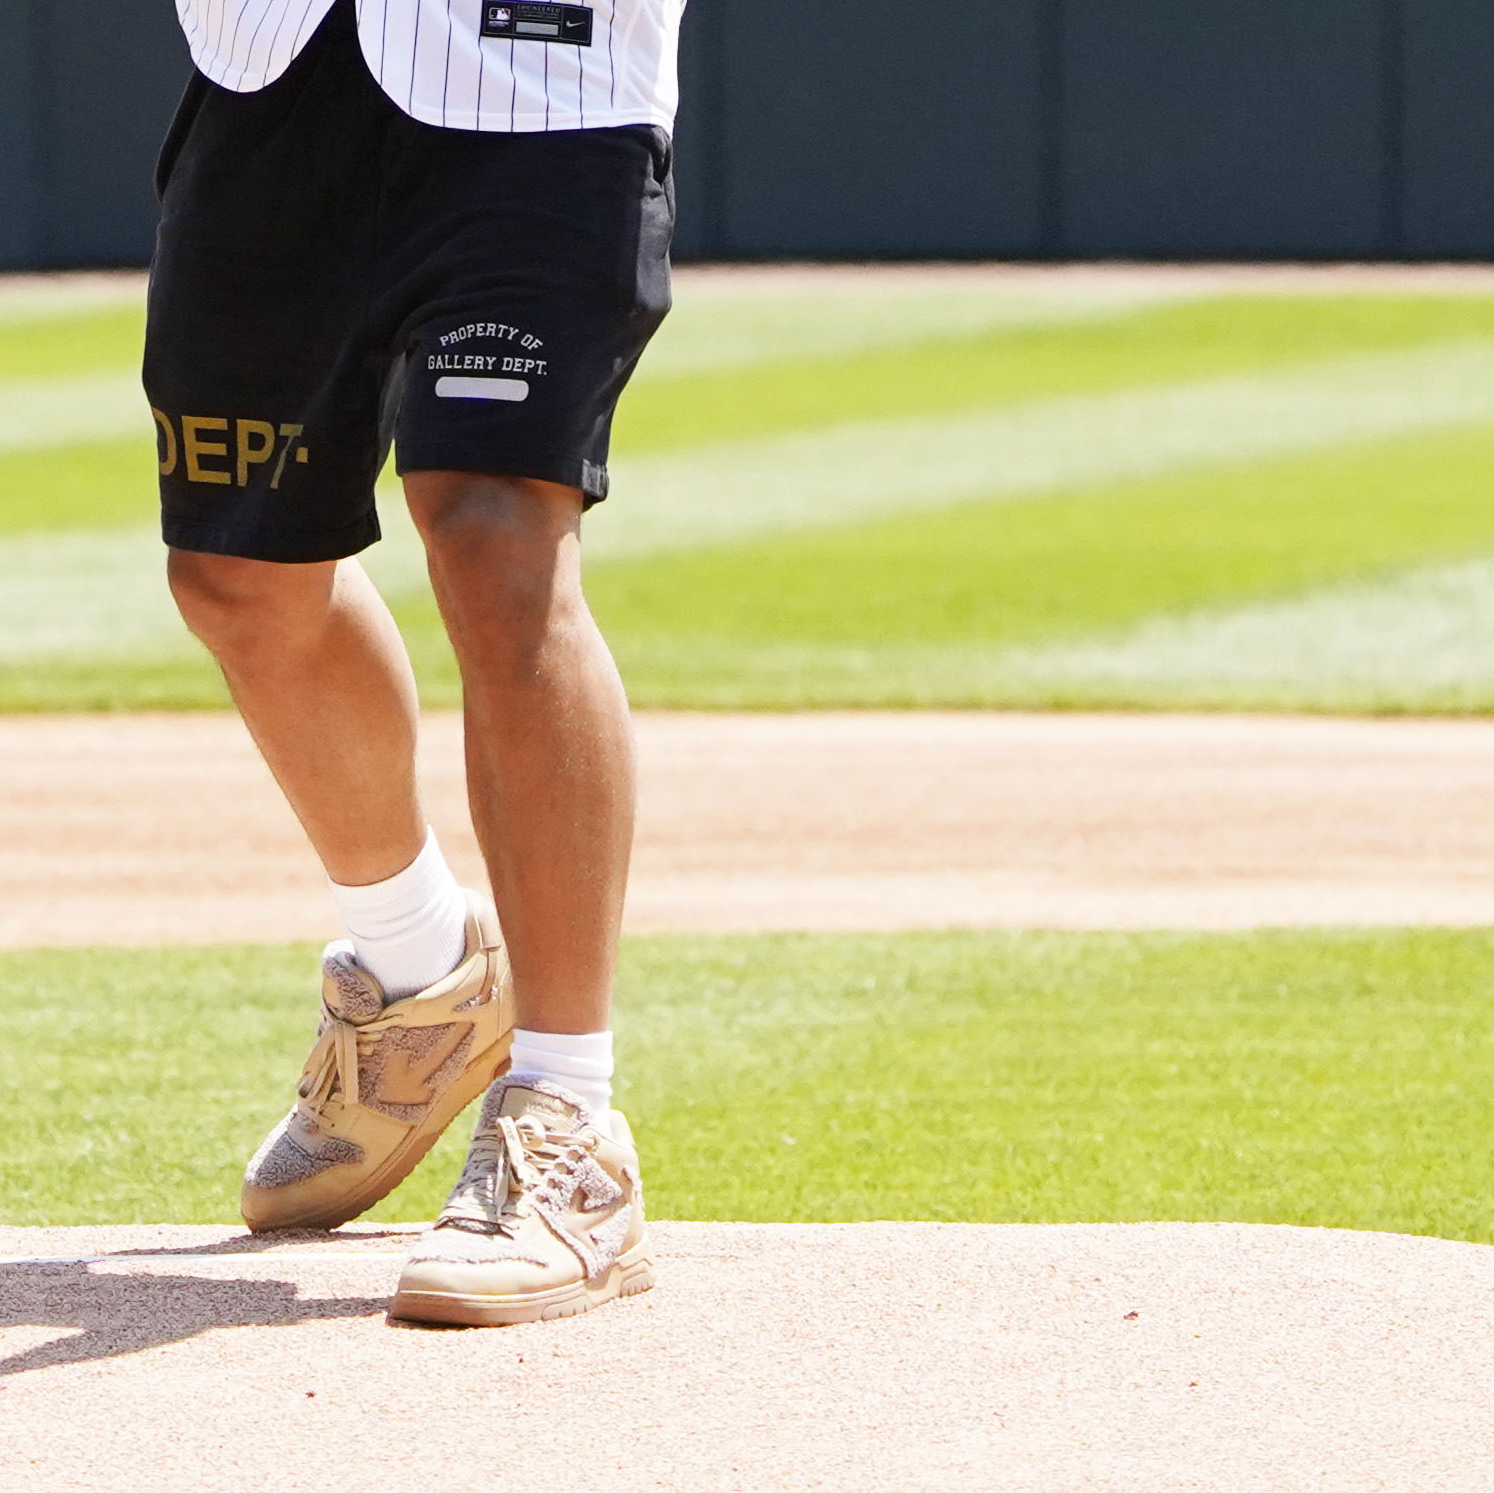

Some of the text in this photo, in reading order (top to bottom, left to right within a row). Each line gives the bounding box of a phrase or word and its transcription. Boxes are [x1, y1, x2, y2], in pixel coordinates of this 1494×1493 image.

[439, 322, 544, 351] PROPERTY OF
[427, 354, 548, 376] GALLERY DEPT.
